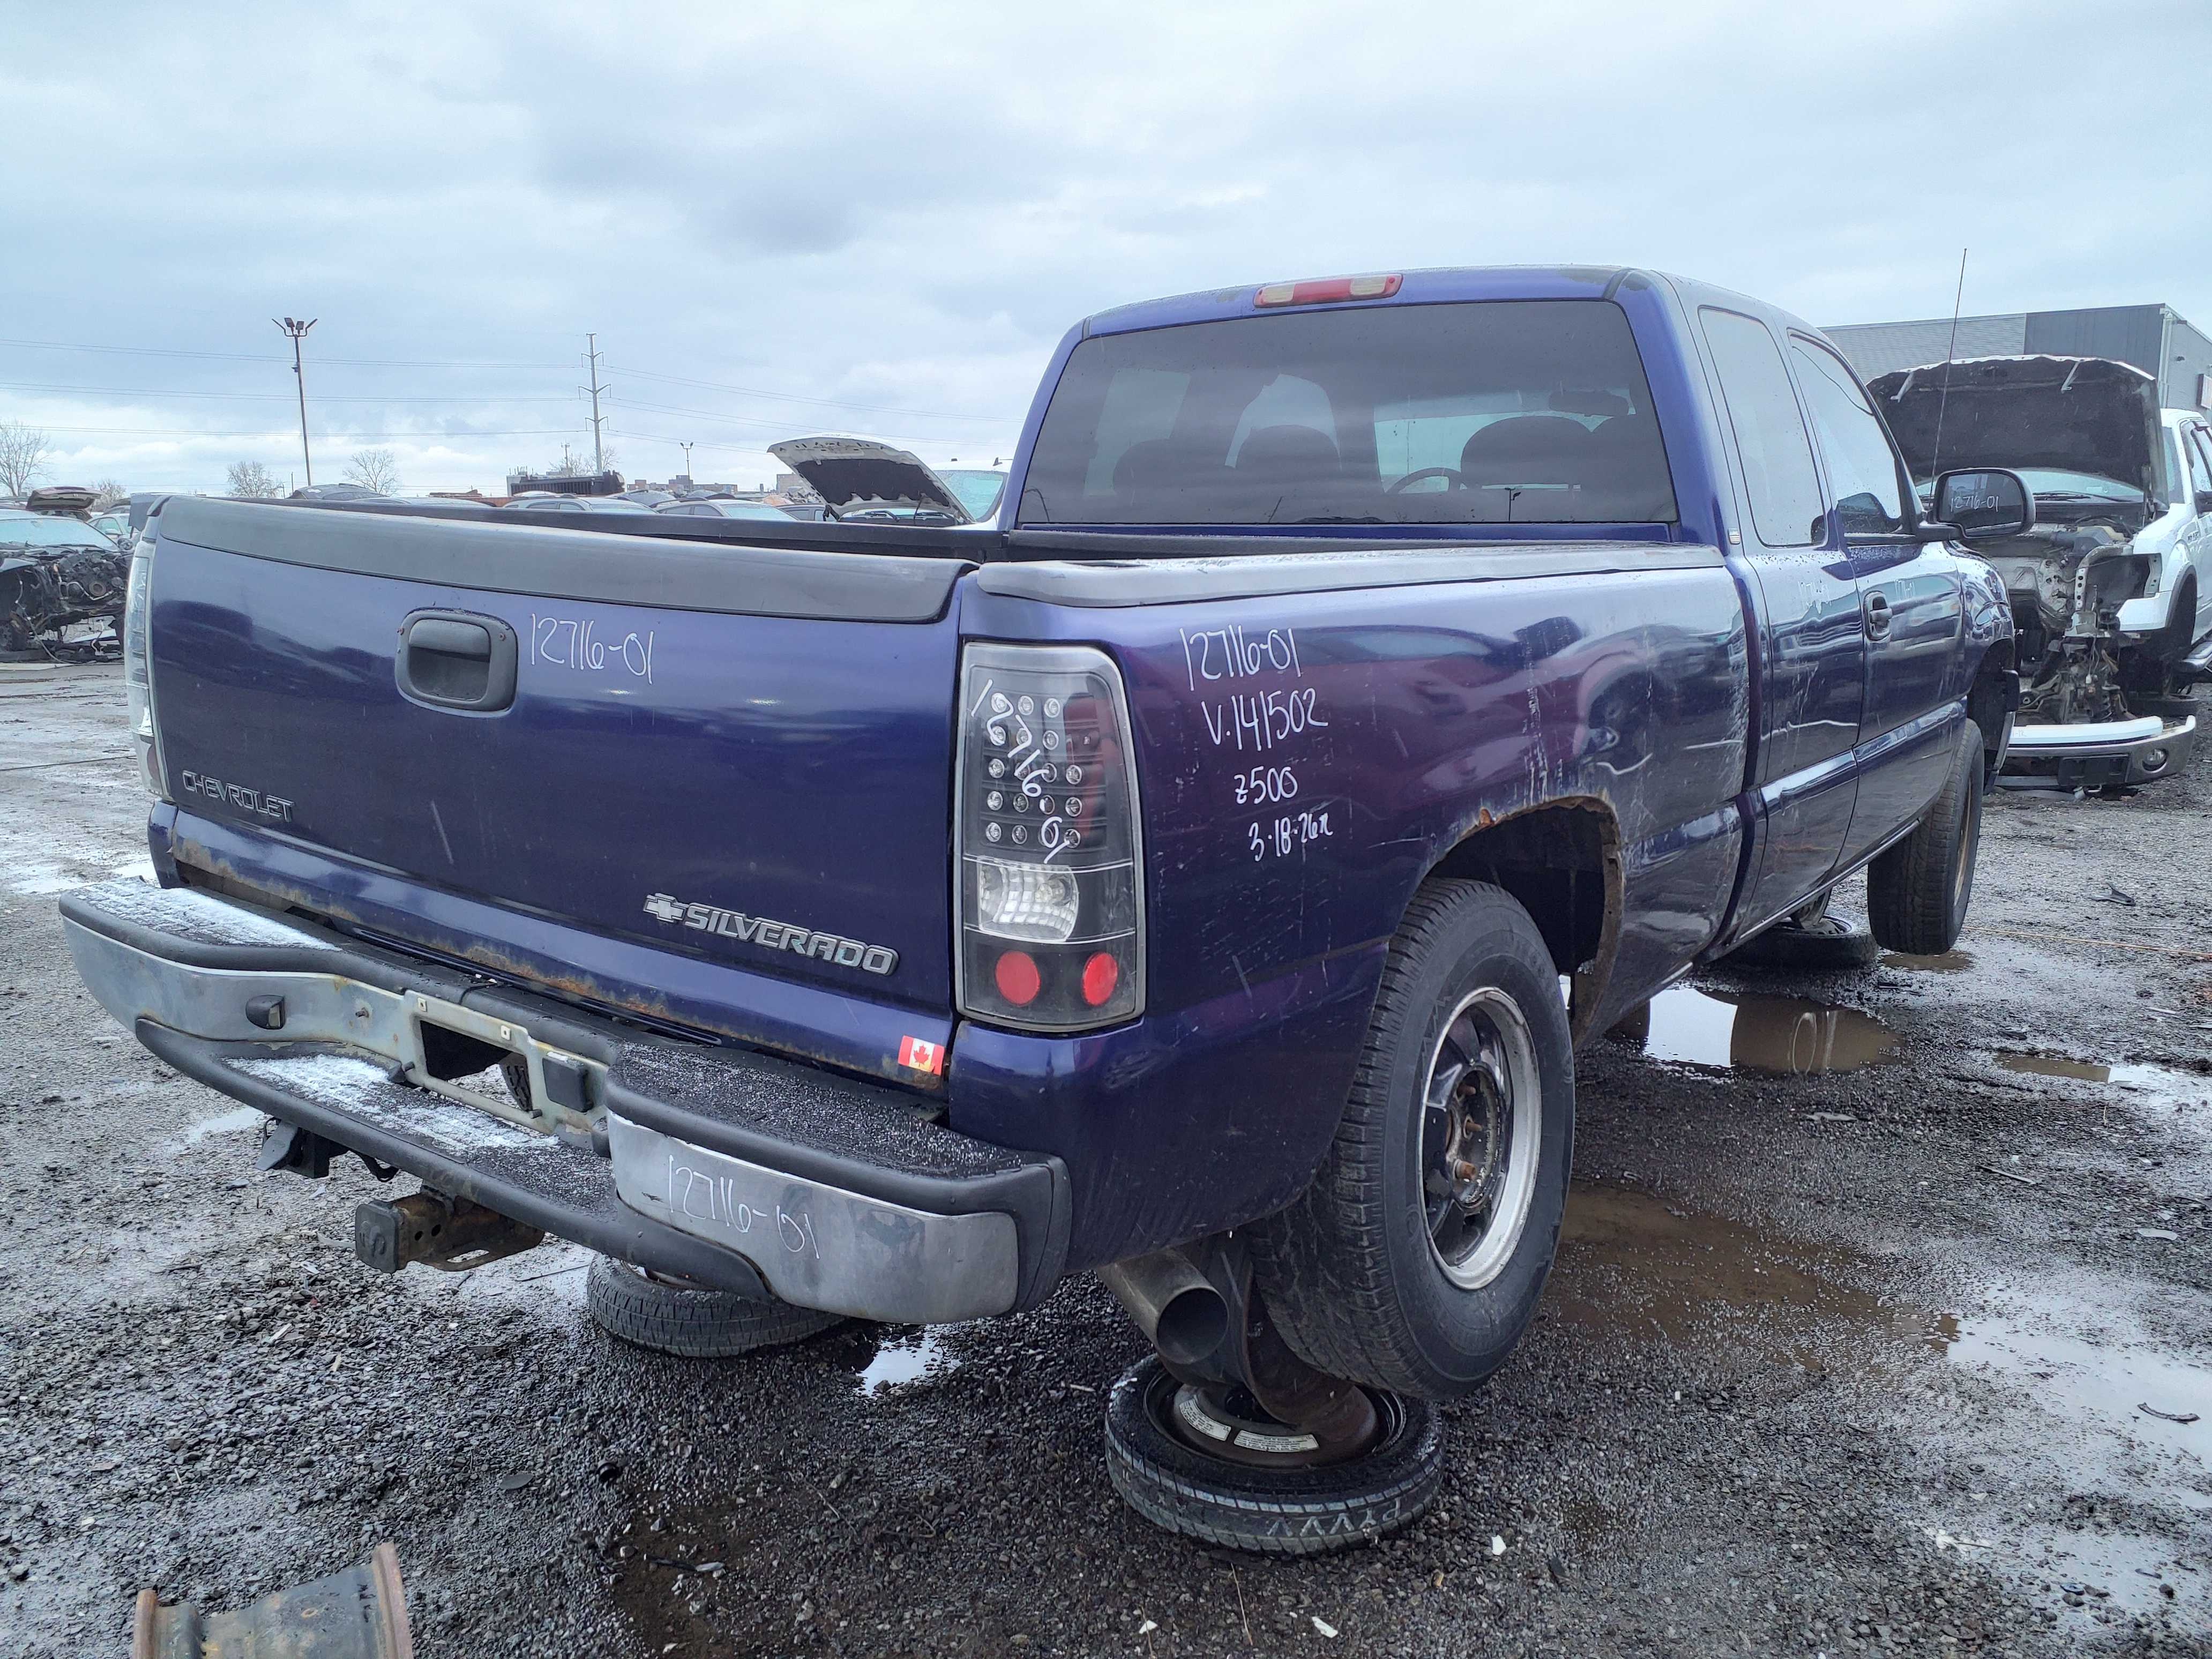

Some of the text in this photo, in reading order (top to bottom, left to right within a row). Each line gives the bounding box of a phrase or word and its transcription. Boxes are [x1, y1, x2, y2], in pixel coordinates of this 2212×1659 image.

[1951, 496, 1999, 512] 12716-01
[531, 613, 654, 684] 12716-01
[1179, 625, 1302, 691] 12716-01
[183, 770, 294, 822] CHEVROLET
[684, 902, 899, 976] SILVERADO
[668, 1154, 820, 1259] 12716-01
